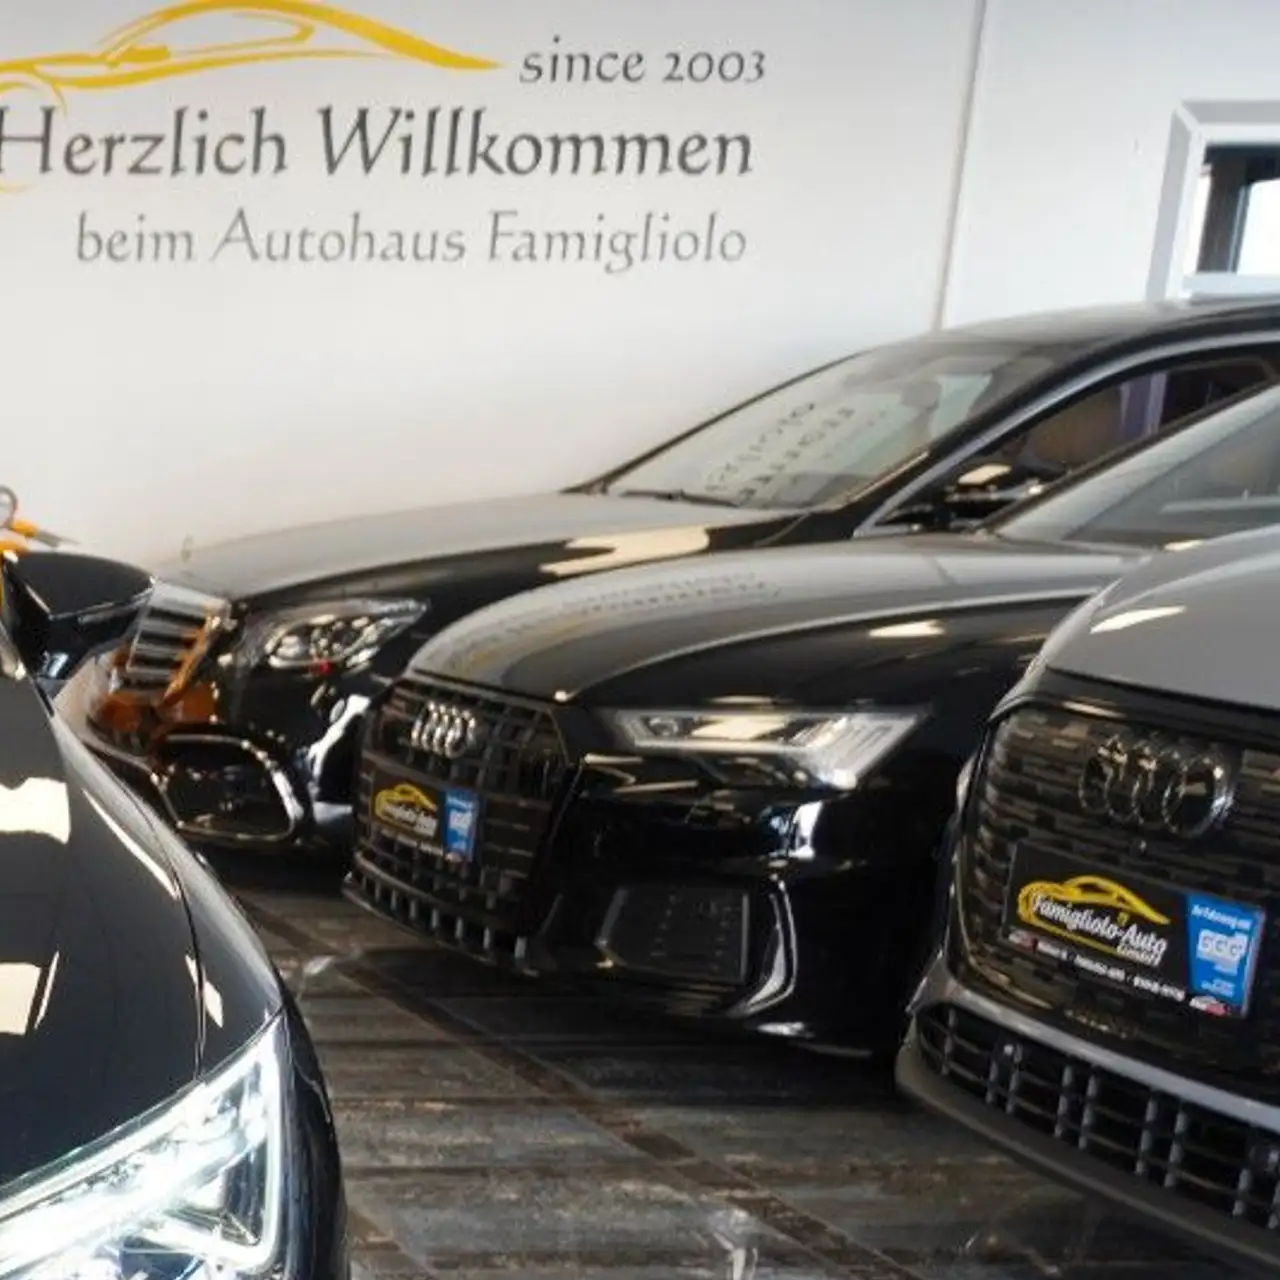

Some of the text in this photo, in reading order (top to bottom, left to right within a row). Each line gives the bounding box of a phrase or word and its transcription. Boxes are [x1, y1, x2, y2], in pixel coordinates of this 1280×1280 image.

[519, 35, 767, 84] since 2003
[317, 104, 753, 178] Willkommen
[76, 206, 747, 274] beim Autohaus Famigliolo
[1033, 894, 1169, 955] Famigliolo-Auto
